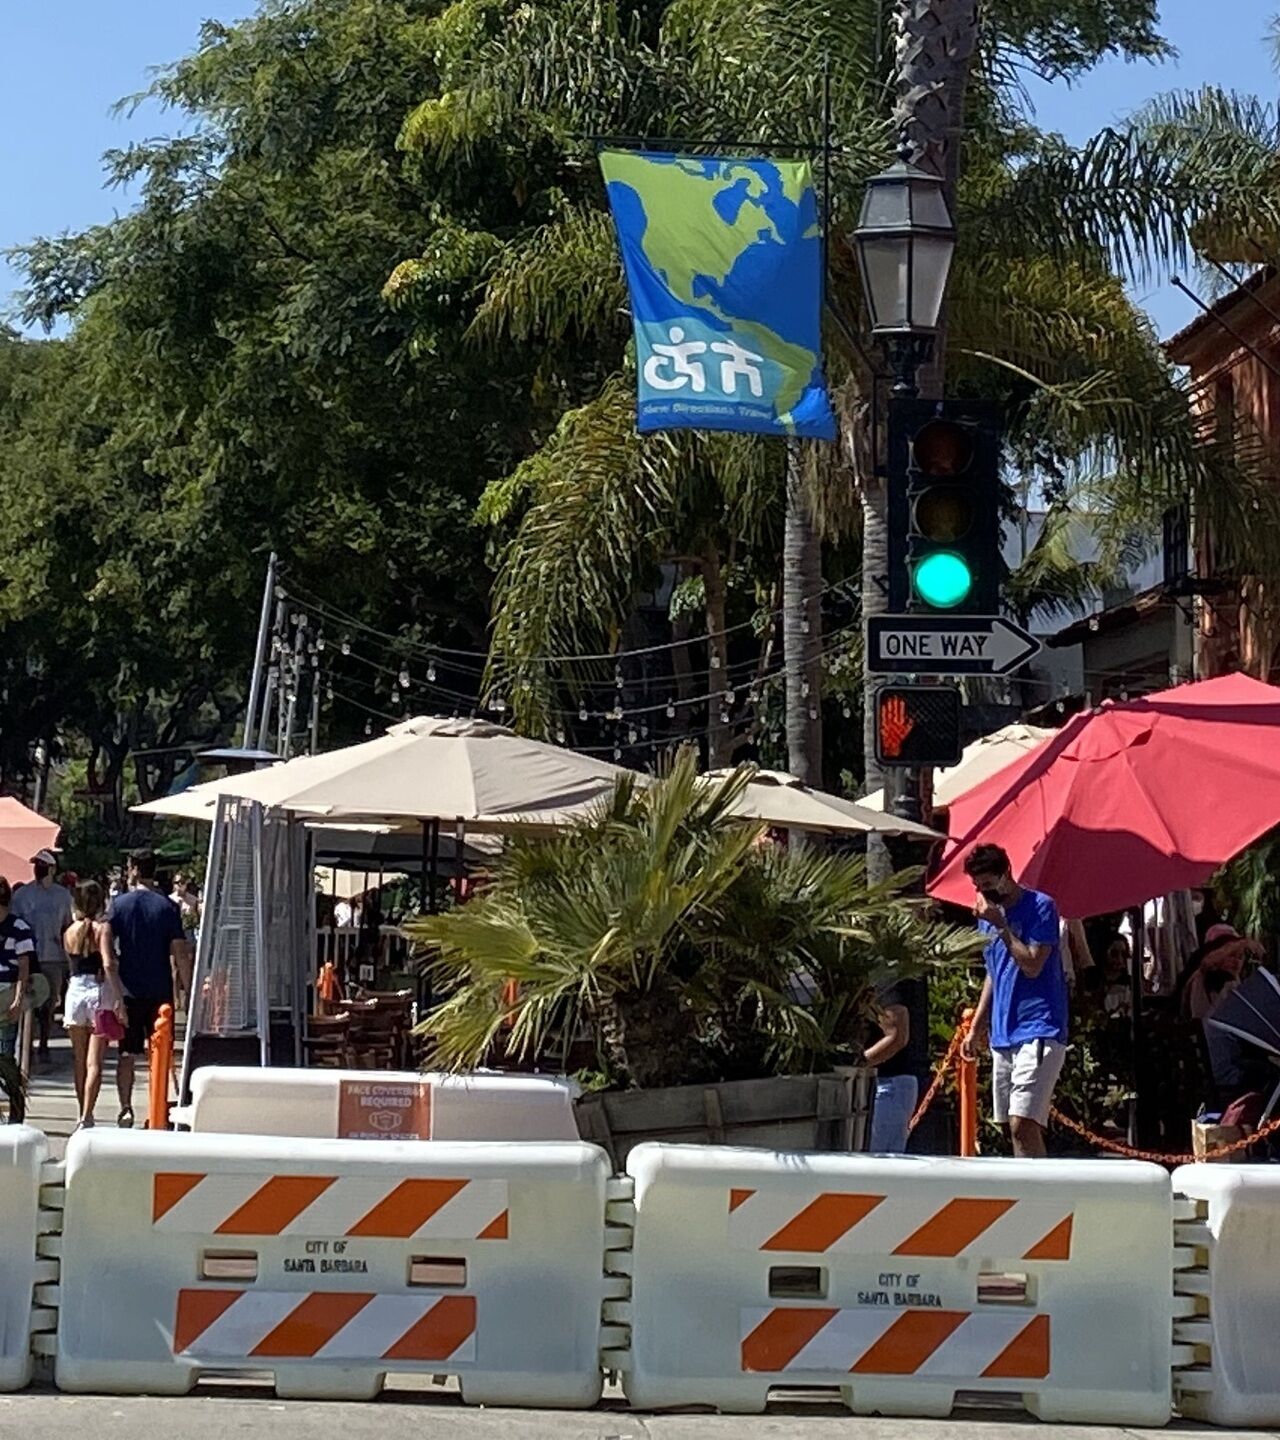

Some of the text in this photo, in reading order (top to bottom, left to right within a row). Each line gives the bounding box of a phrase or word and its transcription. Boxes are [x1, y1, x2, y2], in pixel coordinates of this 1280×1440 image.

[886, 634, 988, 656] ONE WAY
[360, 1097, 412, 1109] REQUIRED
[305, 1241, 348, 1254] CITY OF
[284, 1259, 368, 1273] SANTA BARBARA
[878, 1273, 920, 1287] CITY OF
[857, 1291, 889, 1305] SANTA
